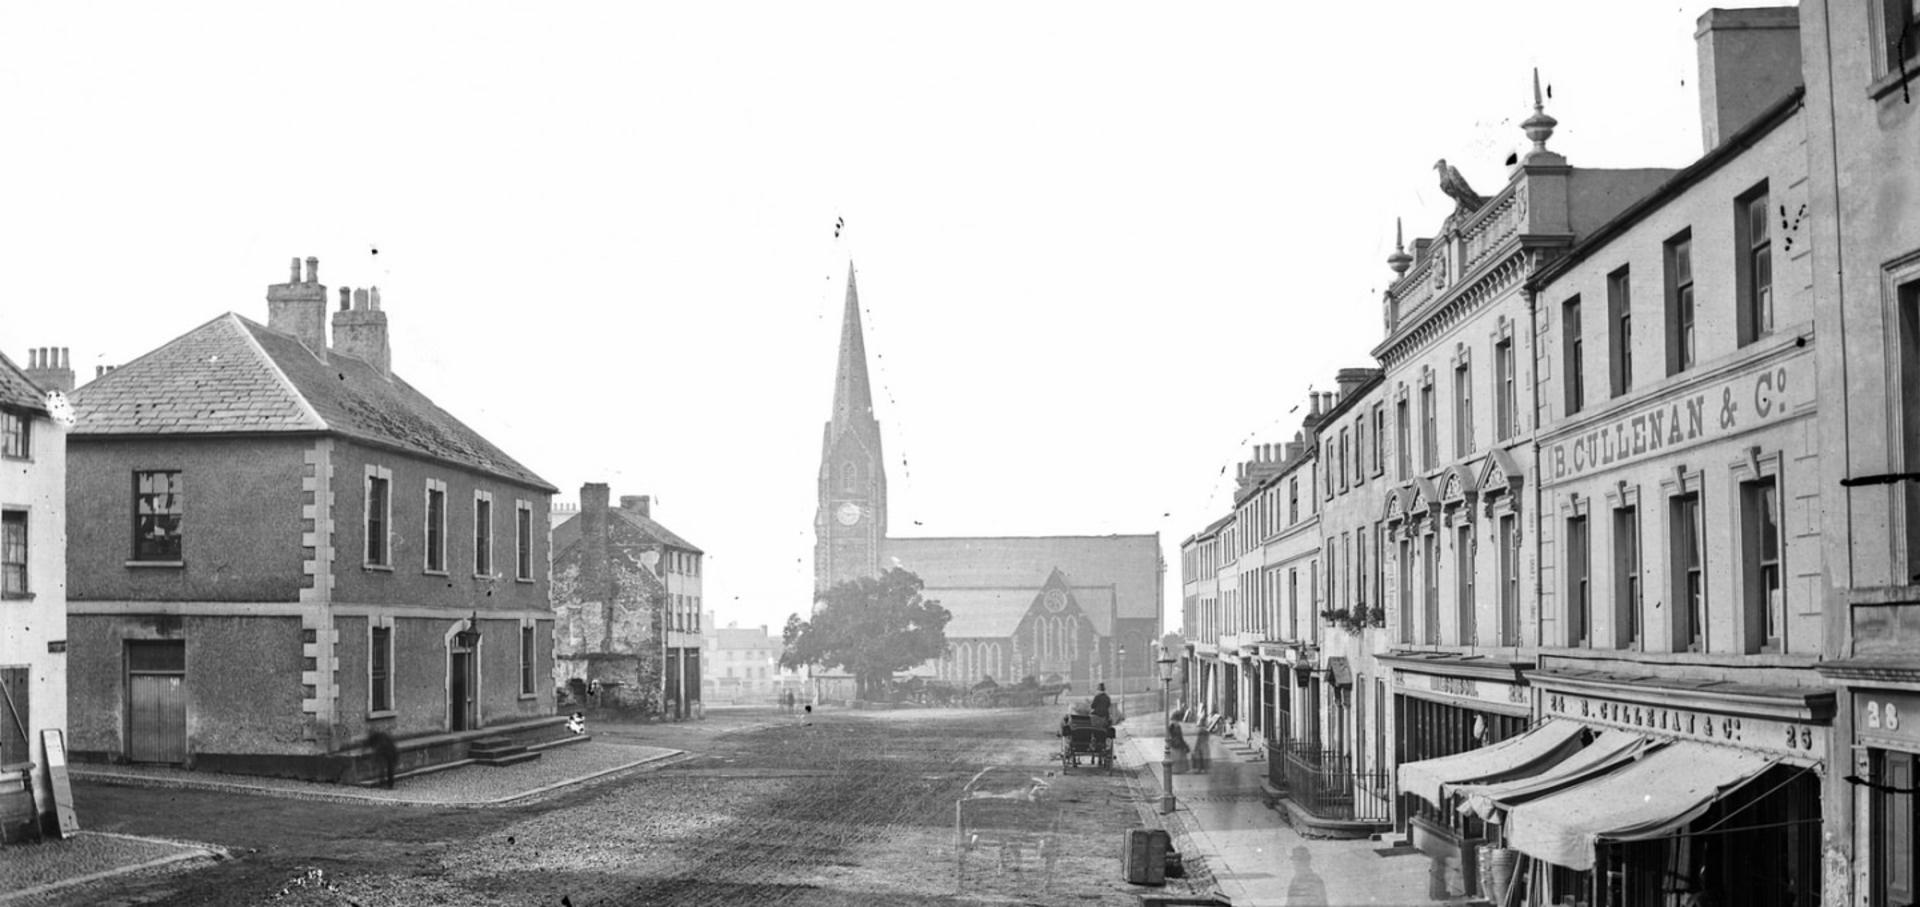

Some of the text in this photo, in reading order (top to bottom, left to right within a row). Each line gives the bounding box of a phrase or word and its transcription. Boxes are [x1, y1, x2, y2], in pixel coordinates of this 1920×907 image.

[1719, 386, 1737, 430] &
[1703, 715, 1714, 737] &
[1867, 700, 1899, 731] 28
